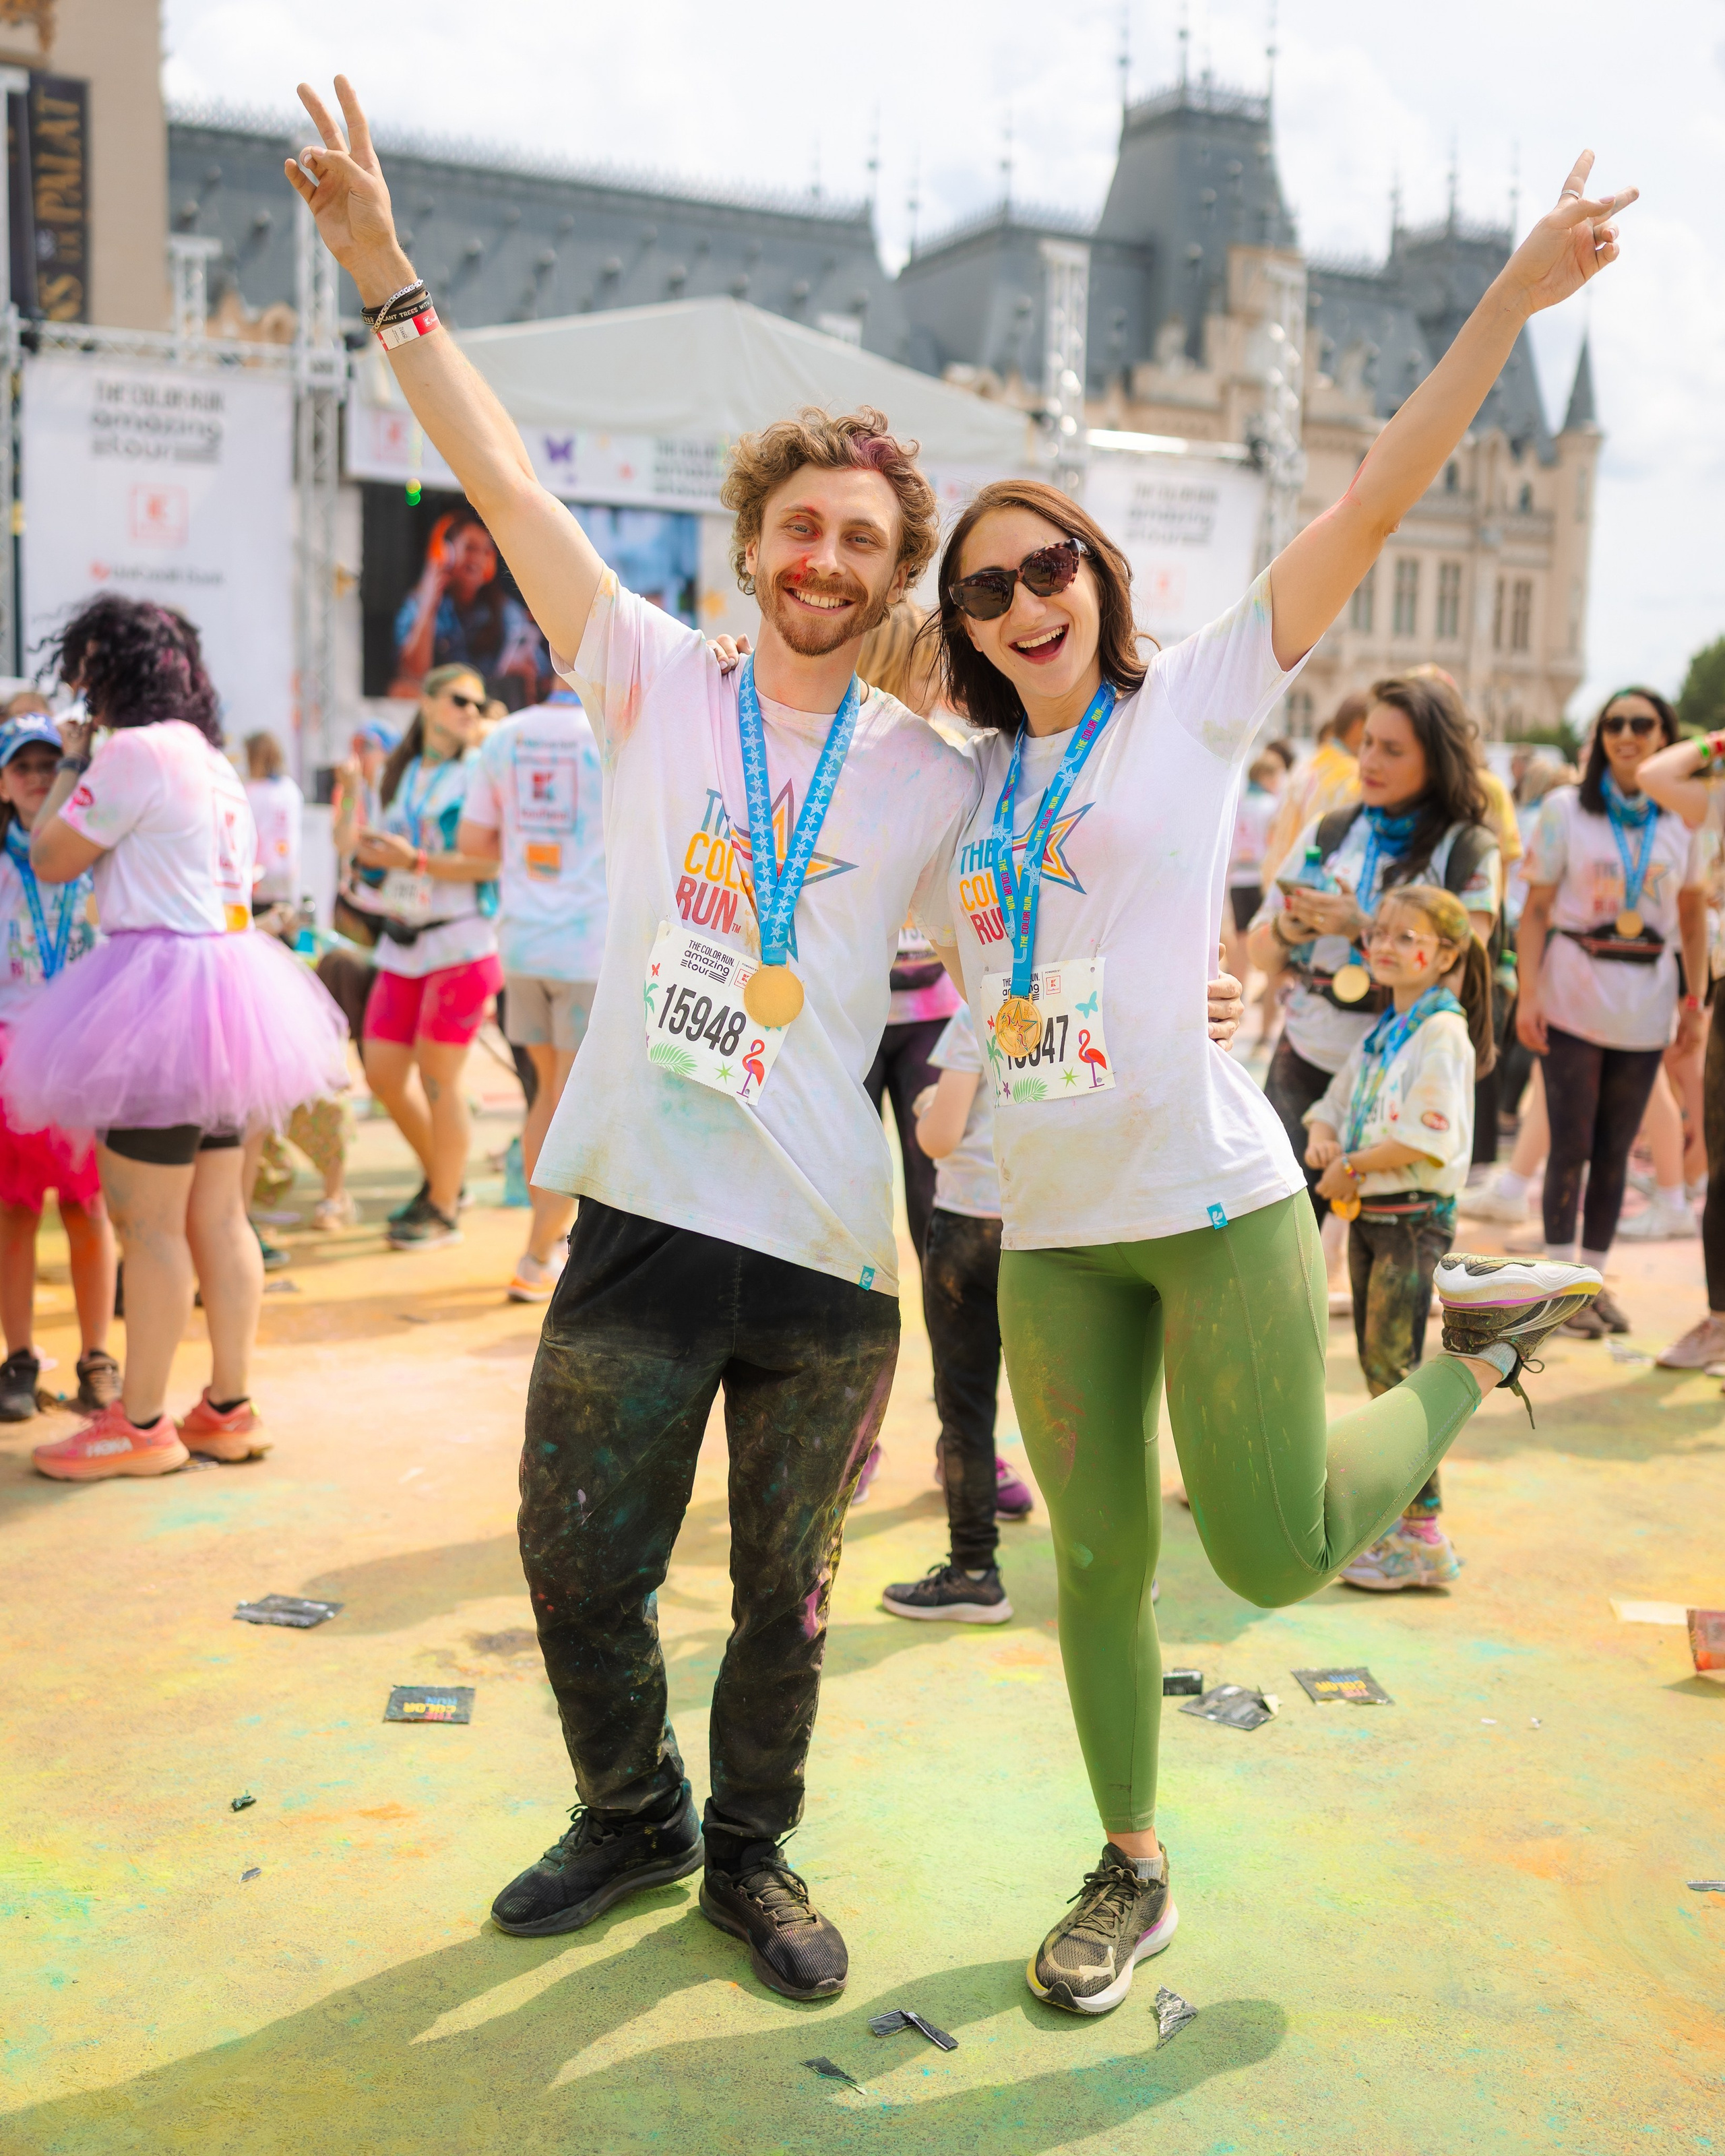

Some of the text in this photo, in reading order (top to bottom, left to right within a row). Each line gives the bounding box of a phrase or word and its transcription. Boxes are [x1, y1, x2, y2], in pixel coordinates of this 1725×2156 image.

[399, 307, 418, 318] TREES
[1075, 708, 1104, 751] THE COLOR RUN
[1034, 796, 1061, 842] THE COLOR RUN
[998, 858, 1016, 910] THE COLOR RUN
[676, 875, 738, 934] RUN
[1020, 896, 1032, 948] THE COLOR RUN
[684, 950, 730, 977] amazing
[687, 959, 710, 976] tour
[688, 939, 702, 952] THE
[701, 945, 722, 961] COLOR
[1003, 978, 1011, 987] THE
[658, 984, 747, 1056] 15948
[403, 1702, 456, 1713] COLOR
